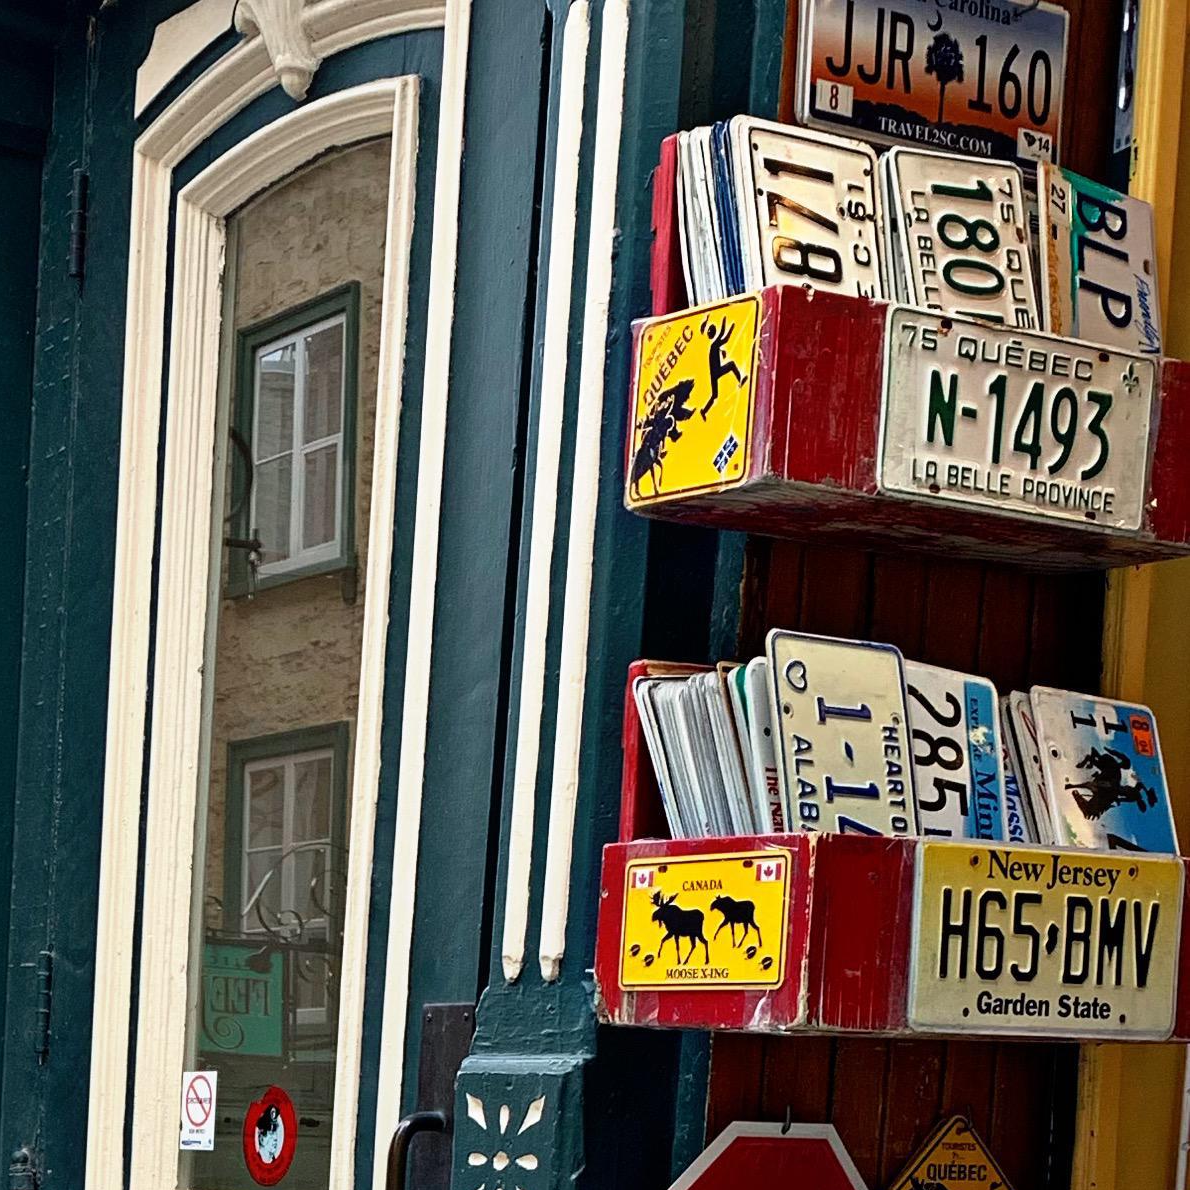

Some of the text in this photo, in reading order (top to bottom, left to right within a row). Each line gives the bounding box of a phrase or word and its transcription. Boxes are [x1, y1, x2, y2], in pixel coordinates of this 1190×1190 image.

[826, 0, 1052, 126] JJR 160
[829, 84, 839, 110] 8
[878, 116, 992, 156] TRAVEL2SC.COM
[1050, 182, 1066, 215] 27
[1076, 192, 1133, 328] BLP
[901, 324, 1094, 382] 75 QUÉBEC
[926, 368, 1113, 481] N-1493
[911, 458, 1115, 514] LA BELLE PROVINCE
[970, 697, 983, 763] EXPLRE
[792, 733, 820, 833] ALAB
[881, 725, 909, 837] HEART O
[1003, 775, 1026, 844] Mass
[682, 879, 723, 892] CANADA
[987, 850, 1121, 894] New Jersey
[666, 967, 729, 979] MOOSE X-ING
[976, 991, 1111, 1019] Garden State
[926, 1160, 988, 1182] QUÉBEC
